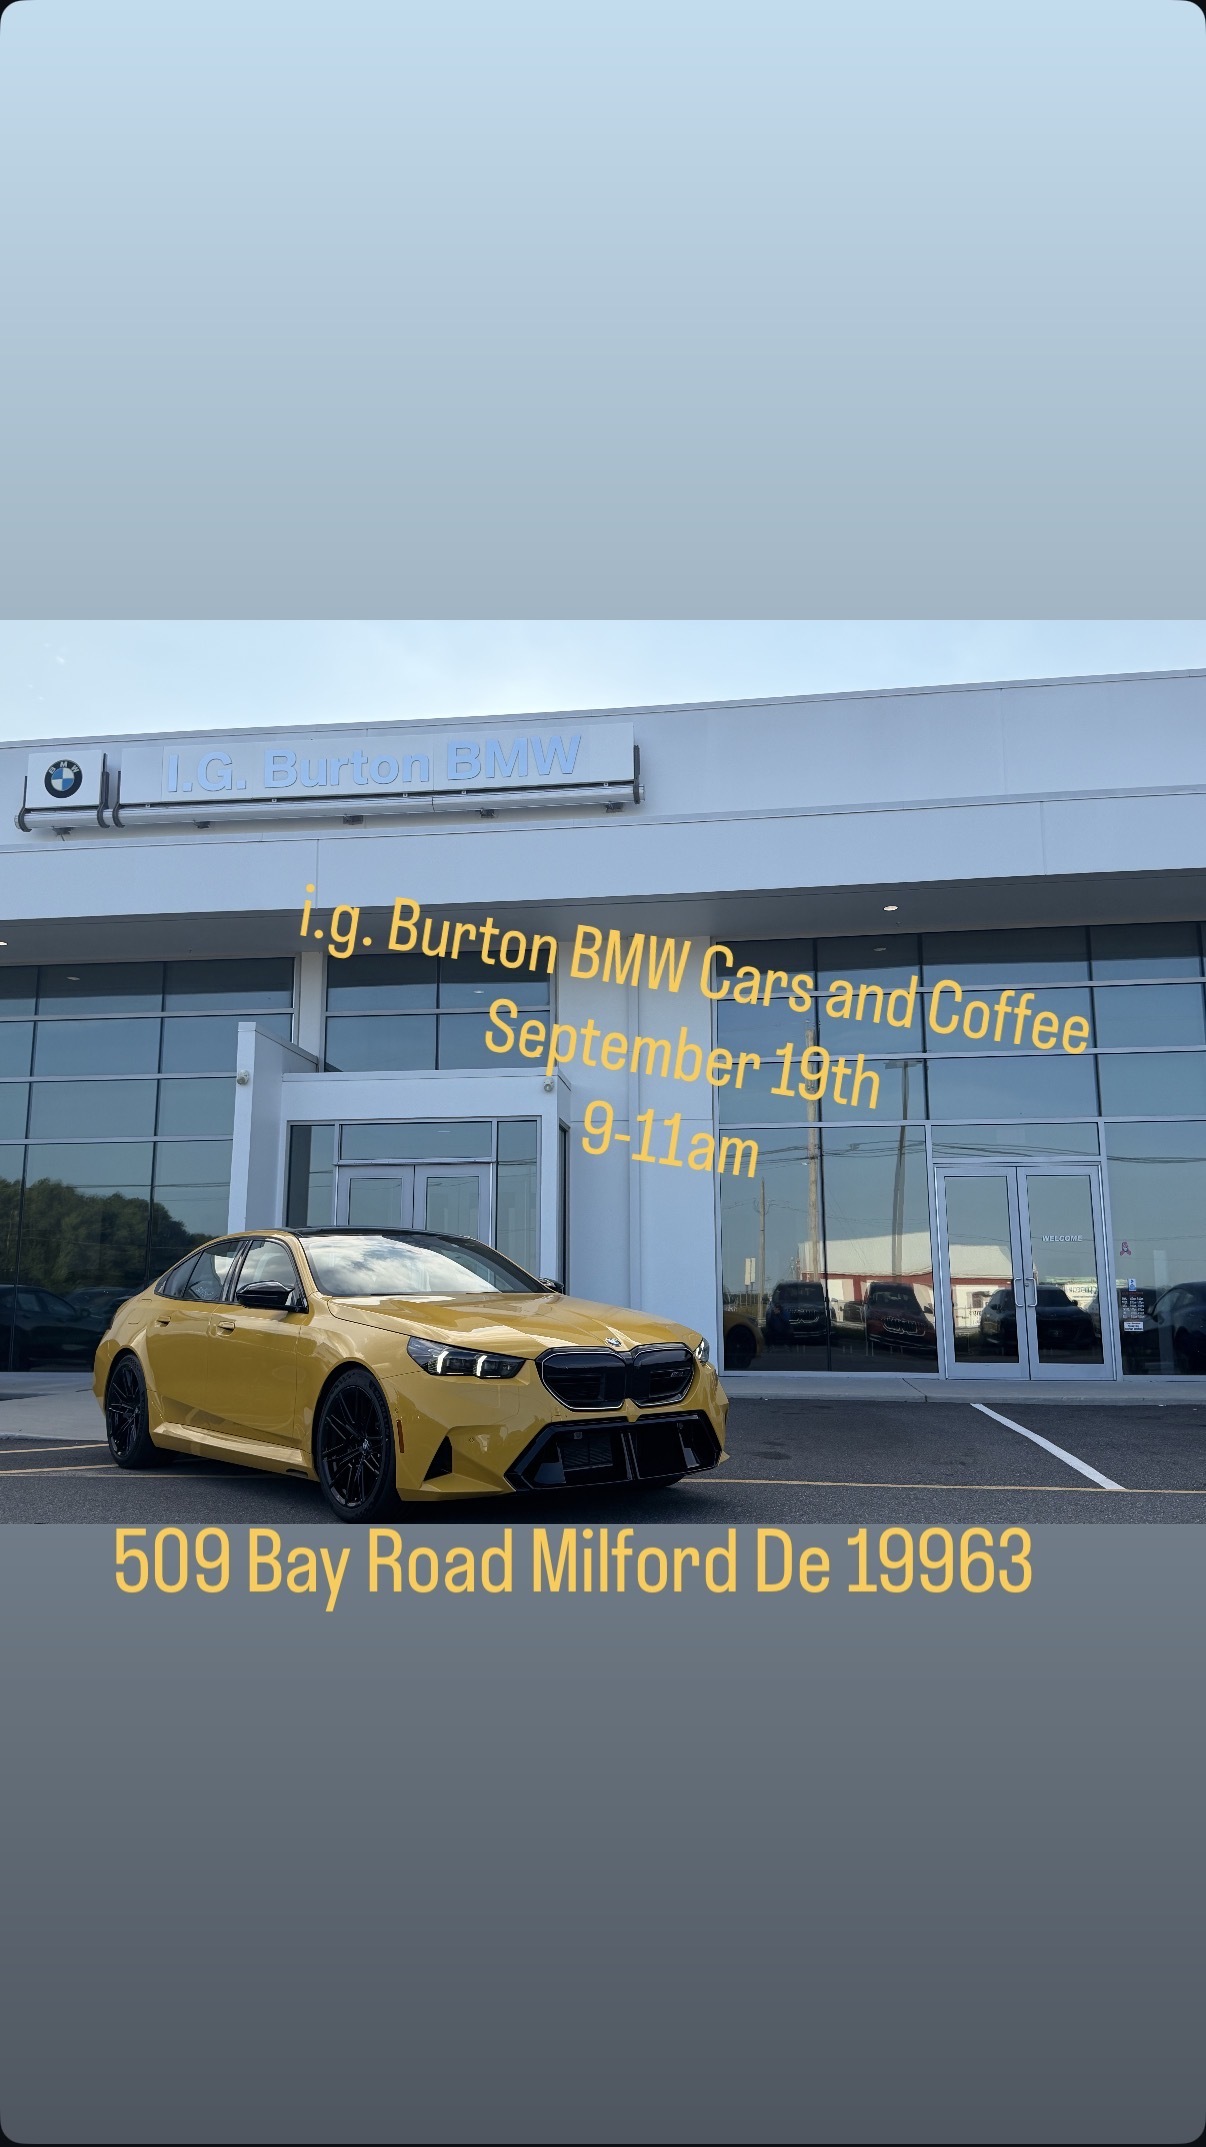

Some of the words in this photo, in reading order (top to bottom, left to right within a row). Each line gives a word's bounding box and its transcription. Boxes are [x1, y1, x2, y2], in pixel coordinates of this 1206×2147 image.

[48, 760, 80, 774] BMW
[167, 751, 247, 792] I.G.
[264, 747, 430, 789] Burton
[447, 735, 582, 781] BMW
